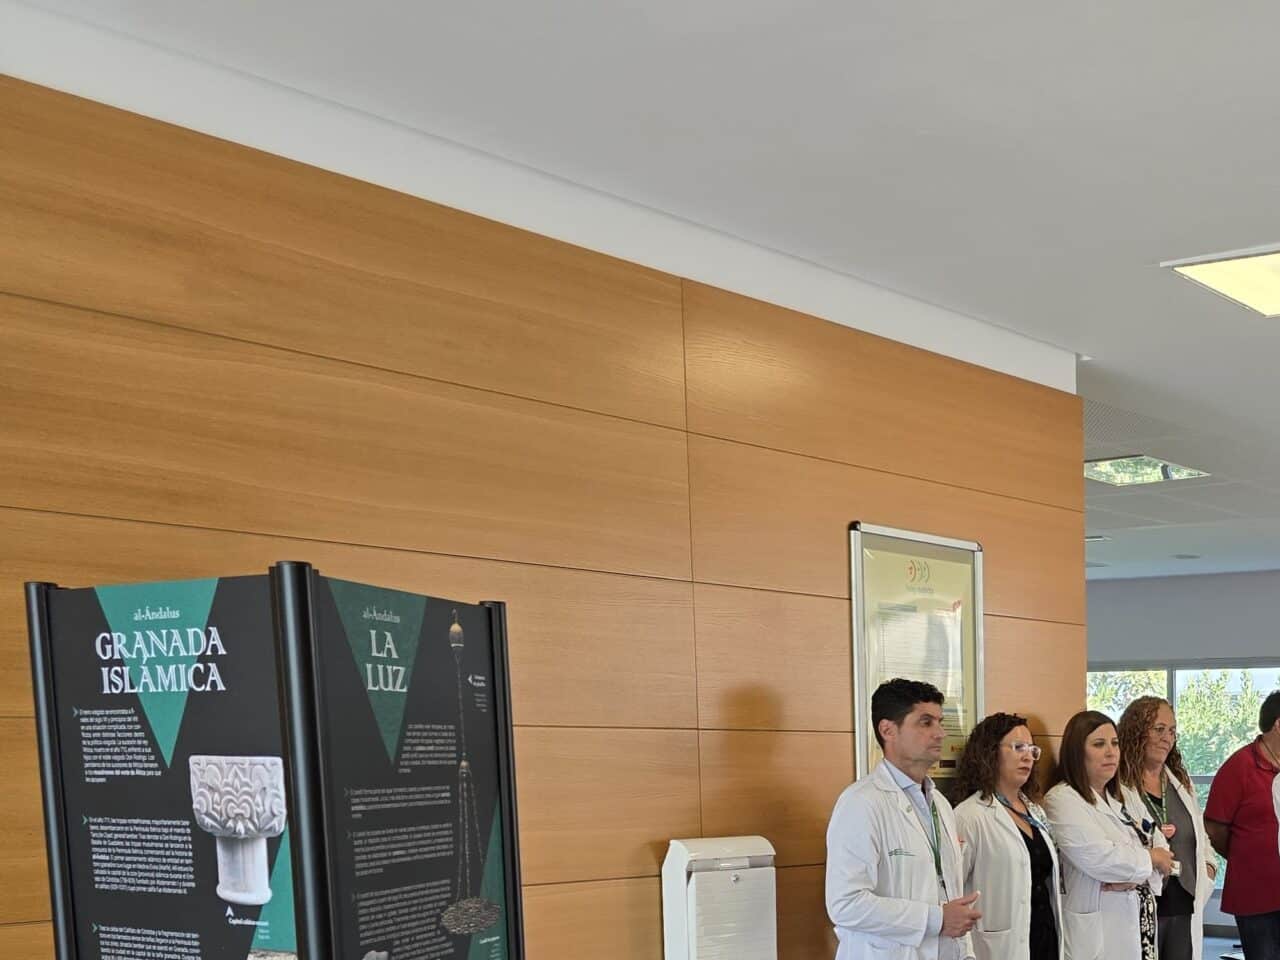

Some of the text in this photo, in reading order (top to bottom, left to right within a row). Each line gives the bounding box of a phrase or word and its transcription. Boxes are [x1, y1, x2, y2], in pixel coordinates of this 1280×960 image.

[95, 626, 227, 660] GRANADA
[369, 629, 399, 659] LA
[101, 660, 226, 694] ISLÁMICA
[366, 663, 408, 692] LUZ
